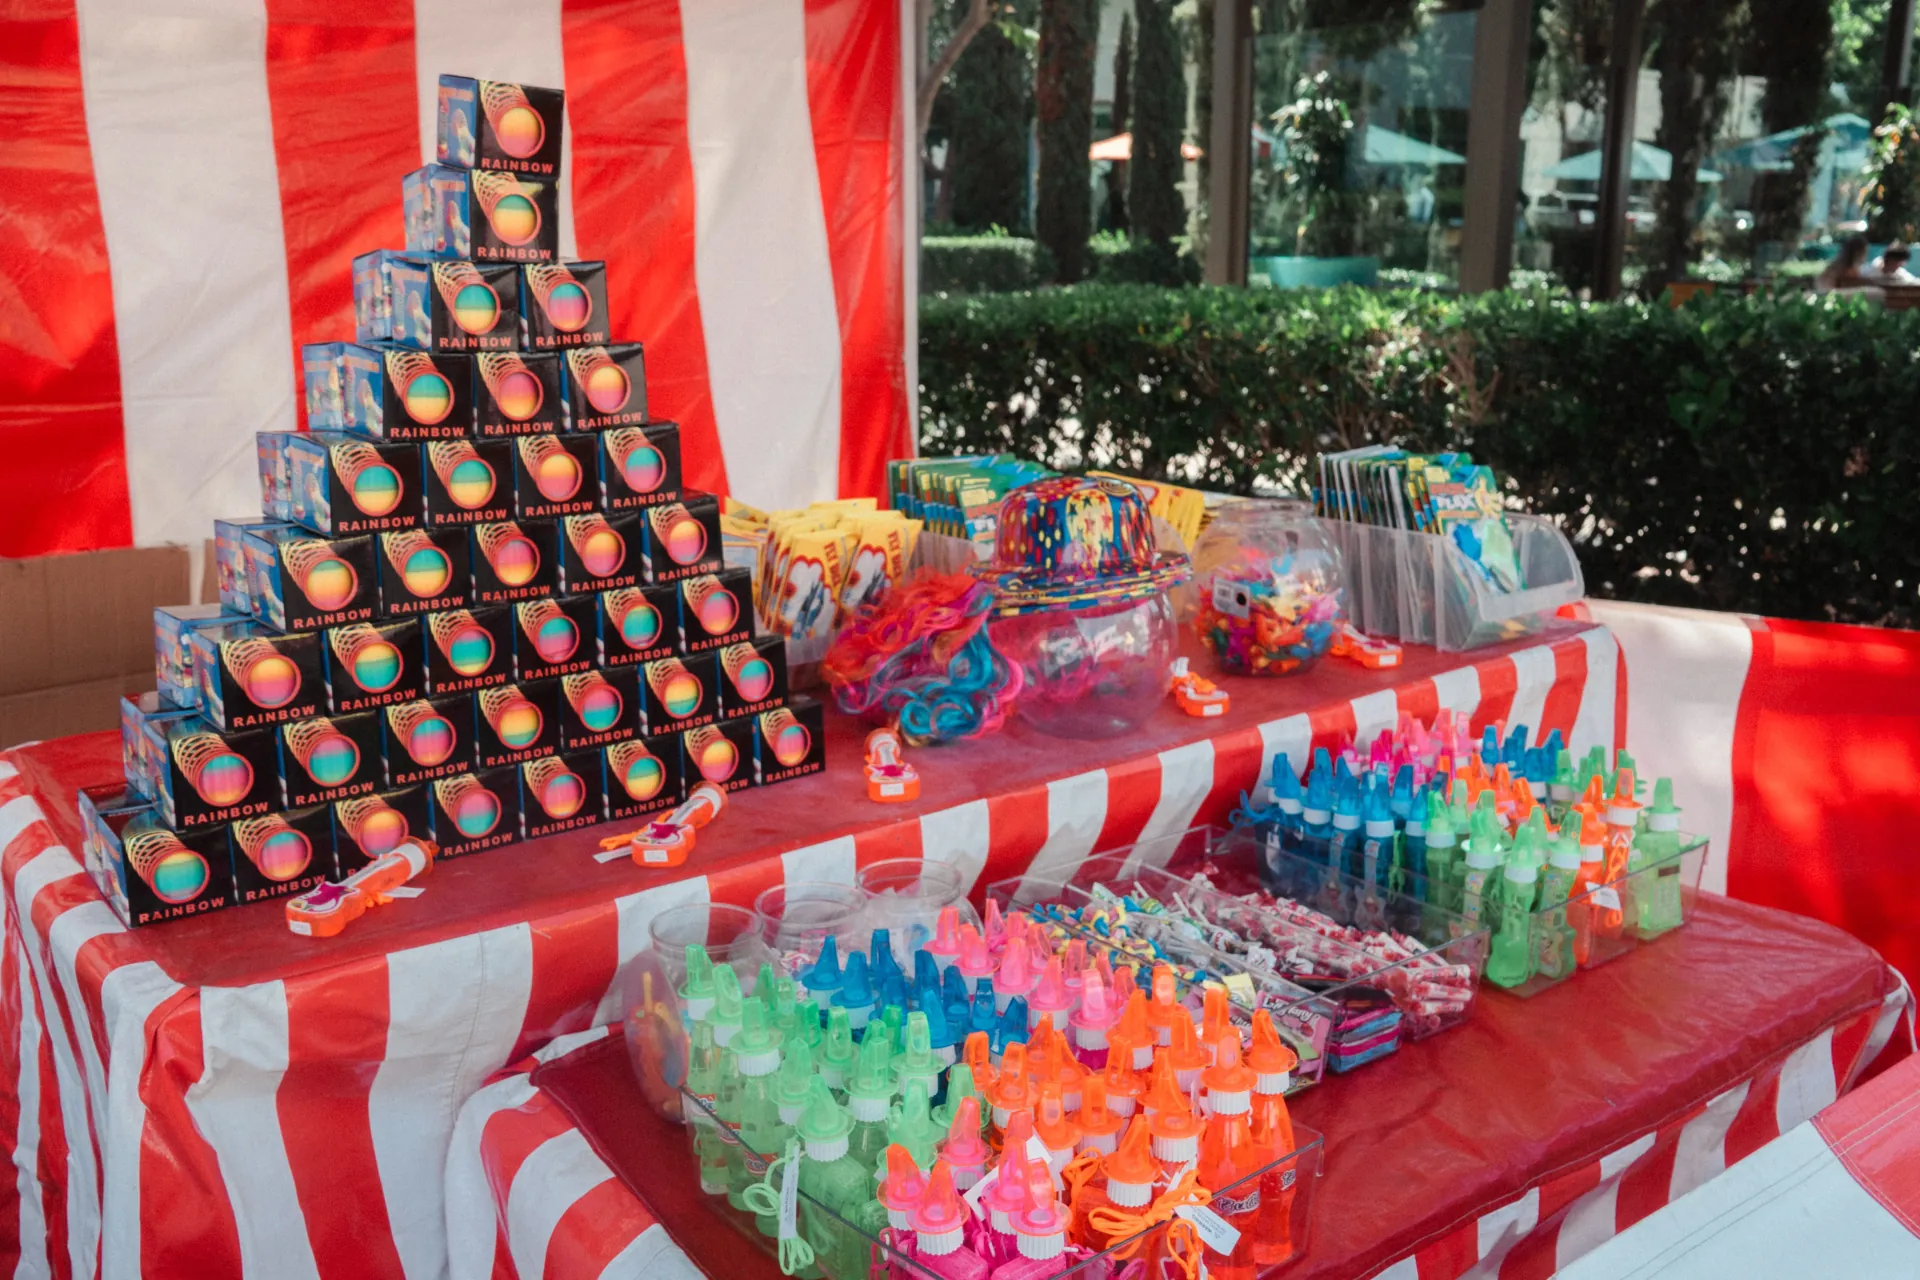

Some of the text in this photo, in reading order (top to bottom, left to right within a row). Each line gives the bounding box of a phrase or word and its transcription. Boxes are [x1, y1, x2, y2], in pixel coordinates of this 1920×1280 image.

[481, 157, 553, 173] RAINBOW
[477, 247, 551, 259] RAINBOW
[440, 337, 511, 348] RAINBOW
[536, 332, 603, 346] RAINBOW
[484, 422, 553, 435] RAINBOW
[578, 412, 641, 429] RAINBOW
[390, 426, 464, 438] RAINBOW
[525, 501, 593, 516] RAINBOW
[613, 491, 676, 508] RAINBOW
[339, 516, 415, 532] RAINBOW
[435, 509, 507, 523] RAINBOW
[658, 561, 718, 581] RAINBOW
[482, 585, 550, 601] RAINBOW
[572, 575, 635, 592] RAINBOW
[390, 596, 464, 614] RAINBOW
[294, 608, 372, 628] RAINBOW
[691, 631, 749, 651] RAINBOW
[610, 647, 672, 665] RAINBOW
[525, 660, 590, 679] RAINBOW
[437, 674, 506, 692] RAINBOW
[341, 688, 416, 711] RAINBOW
[728, 697, 783, 718] RAINBOW
[233, 705, 315, 727] RAINBOW
[654, 714, 713, 734] RAINBOW
[570, 728, 633, 747] RAINBOW
[486, 746, 554, 765] RAINBOW
[397, 761, 468, 784] RAINBOW
[766, 762, 819, 782] RAINBOW
[296, 782, 374, 805] RAINBOW
[184, 802, 268, 825] RAINBOW
[615, 796, 675, 817] RAINBOW
[532, 814, 596, 836] RAINBOW
[444, 832, 513, 856] RAINBOW
[246, 874, 326, 901] RAINBOW
[139, 897, 225, 923] RAINBOW
